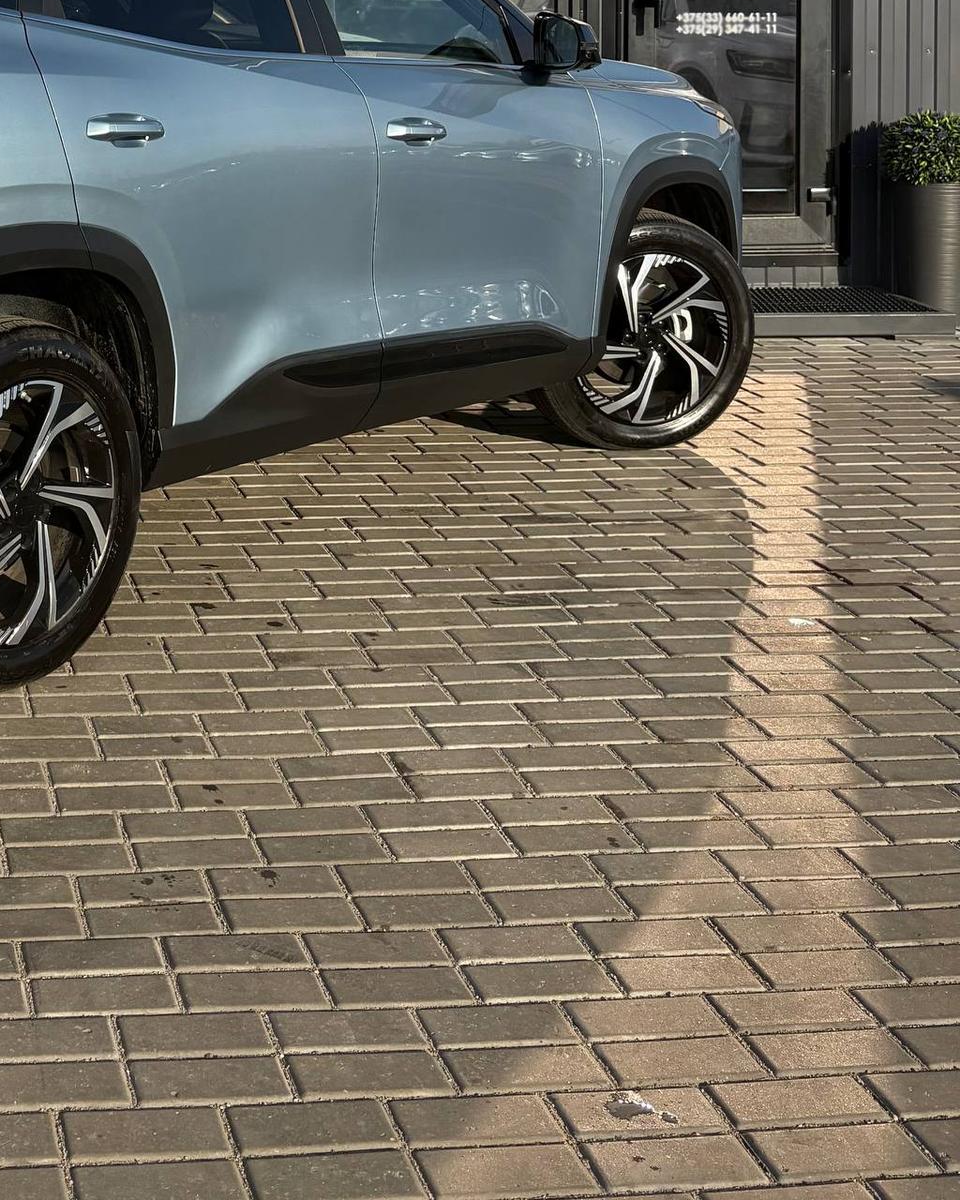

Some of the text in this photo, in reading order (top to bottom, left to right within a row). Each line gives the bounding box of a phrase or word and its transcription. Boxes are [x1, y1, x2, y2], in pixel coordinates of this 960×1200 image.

[676, 12, 777, 23] +375(33) 660-61-11
[676, 24, 723, 36] +375(29)
